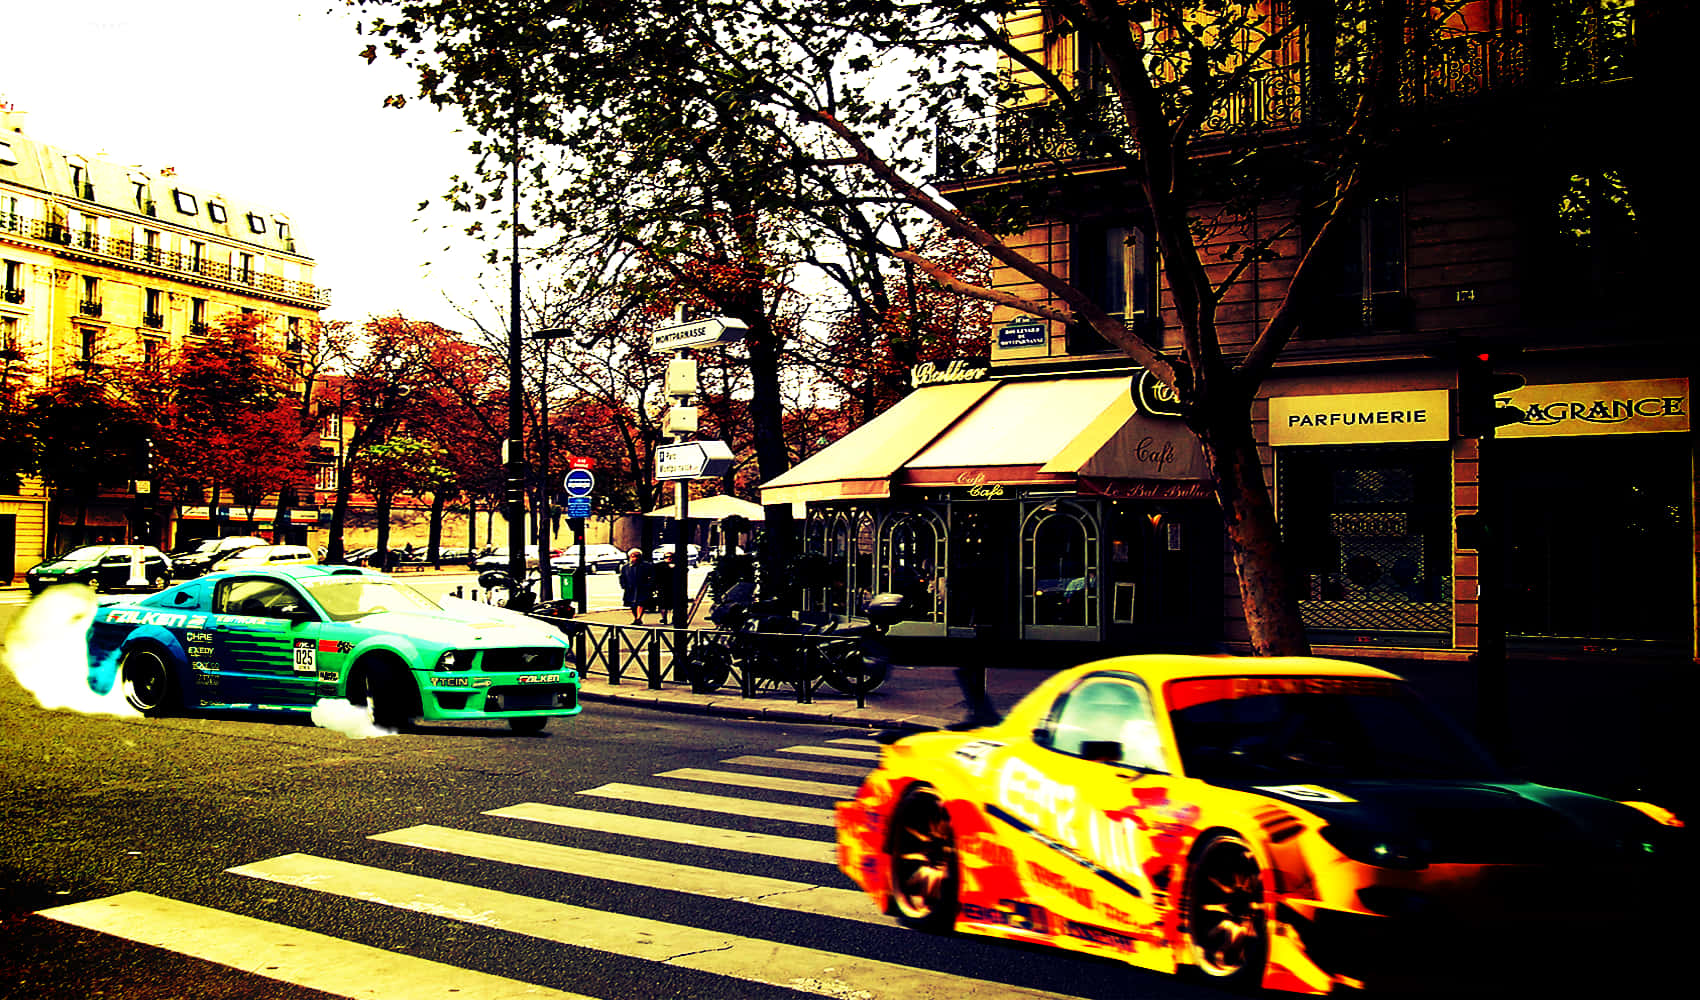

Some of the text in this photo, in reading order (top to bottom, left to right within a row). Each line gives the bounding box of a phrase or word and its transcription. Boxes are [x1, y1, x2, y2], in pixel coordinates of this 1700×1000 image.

[1456, 289, 1475, 302] 174
[655, 326, 707, 345] MONTPARNASSE
[1288, 410, 1427, 428] PARFUMERIE
[1494, 397, 1686, 425] AGRANCE
[1134, 436, 1175, 472] Café
[967, 483, 1005, 501] Café
[1126, 484, 1160, 497] Bal
[106, 610, 187, 628] FALKEN
[296, 649, 313, 666] 025
[517, 674, 560, 684] FALKEN
